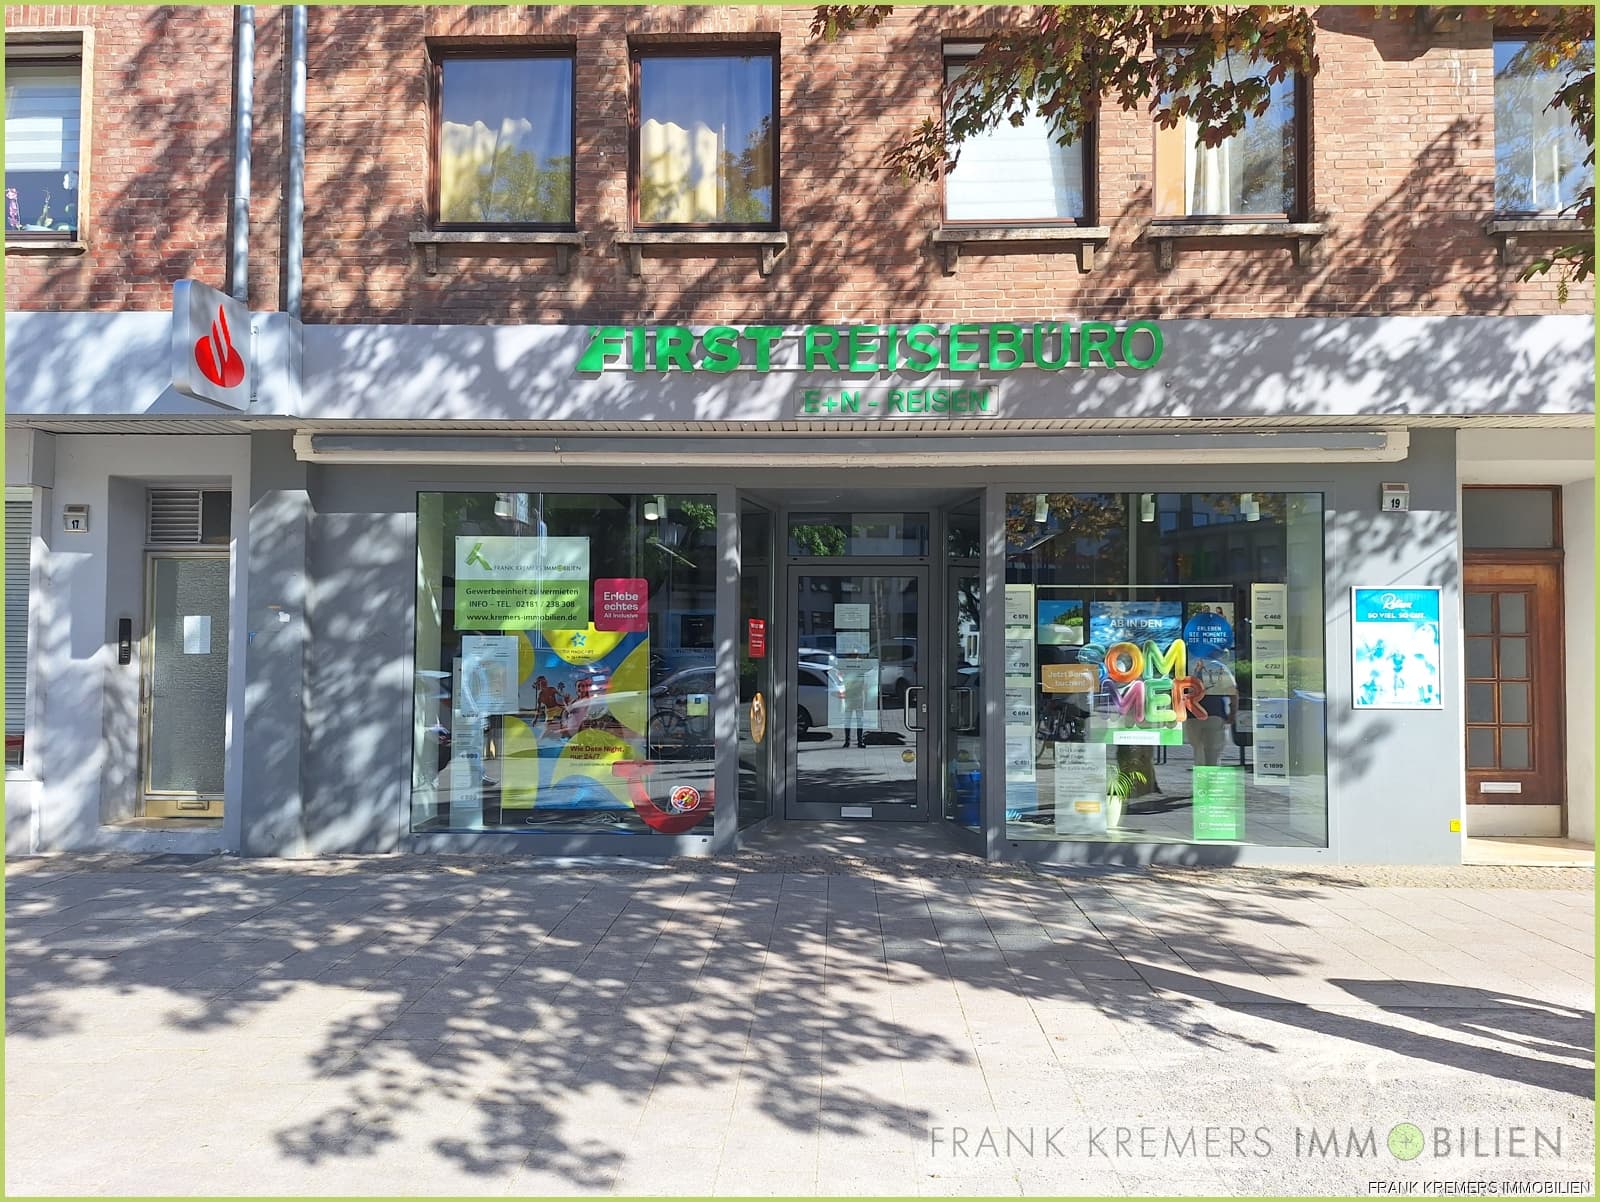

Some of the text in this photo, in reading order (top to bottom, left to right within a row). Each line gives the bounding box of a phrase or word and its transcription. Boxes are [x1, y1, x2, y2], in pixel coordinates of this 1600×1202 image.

[575, 320, 1164, 373] FIRST REISEBÜRO
[803, 389, 860, 413] E+N
[887, 388, 990, 413] REISEN
[1391, 498, 1401, 508] 19
[71, 519, 80, 529] 17
[466, 587, 527, 596] Gewerbeeinheit
[541, 588, 579, 596] vermieten
[603, 591, 639, 601] Erlebe
[469, 600, 488, 608] INFO
[515, 600, 539, 608] 02181
[546, 600, 560, 608] 238
[562, 600, 576, 608] 308
[603, 602, 639, 611] echtes
[466, 613, 578, 622] www.kremers-immobilien.de
[1110, 619, 1163, 628] AB IN DEN
[1101, 677, 1208, 722] MER
